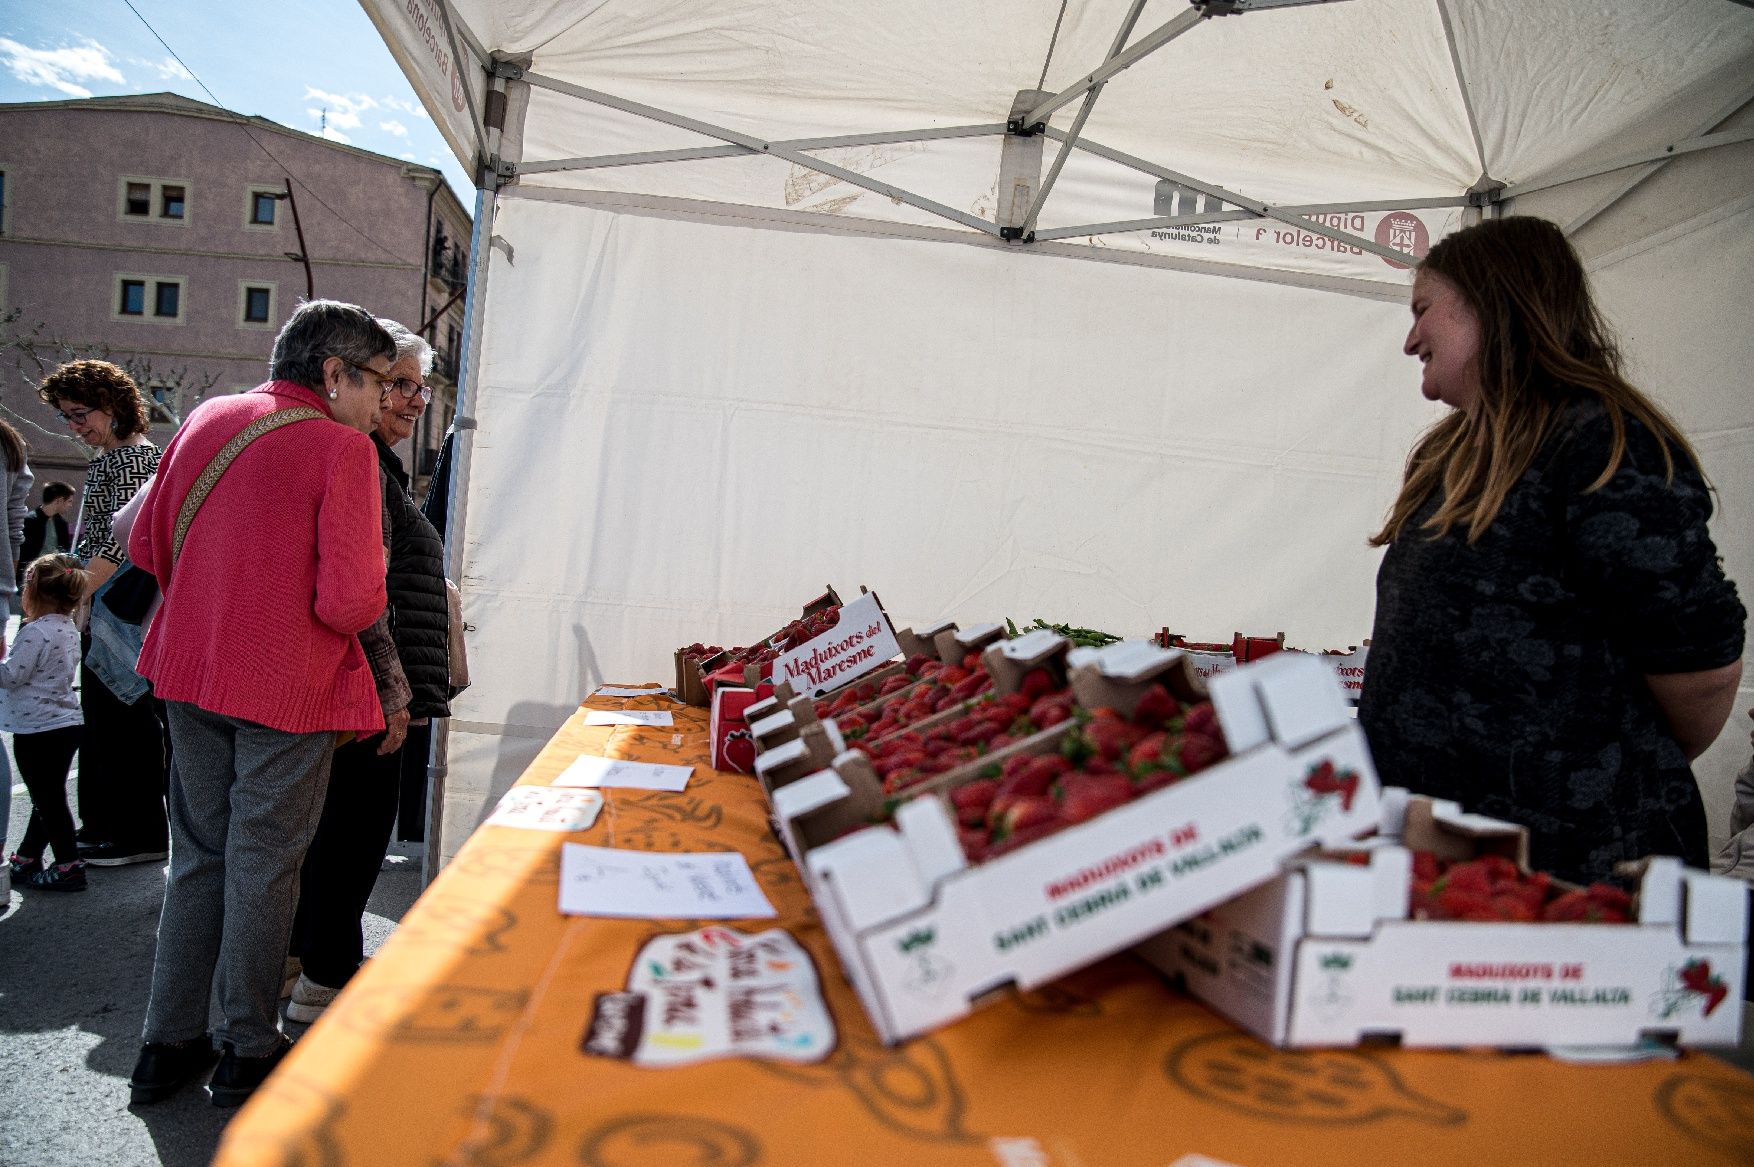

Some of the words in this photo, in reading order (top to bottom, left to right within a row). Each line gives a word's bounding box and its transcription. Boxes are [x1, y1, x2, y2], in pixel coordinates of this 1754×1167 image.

[783, 631, 864, 681] Maduixots
[865, 621, 882, 639] del
[805, 645, 876, 690] Maresme
